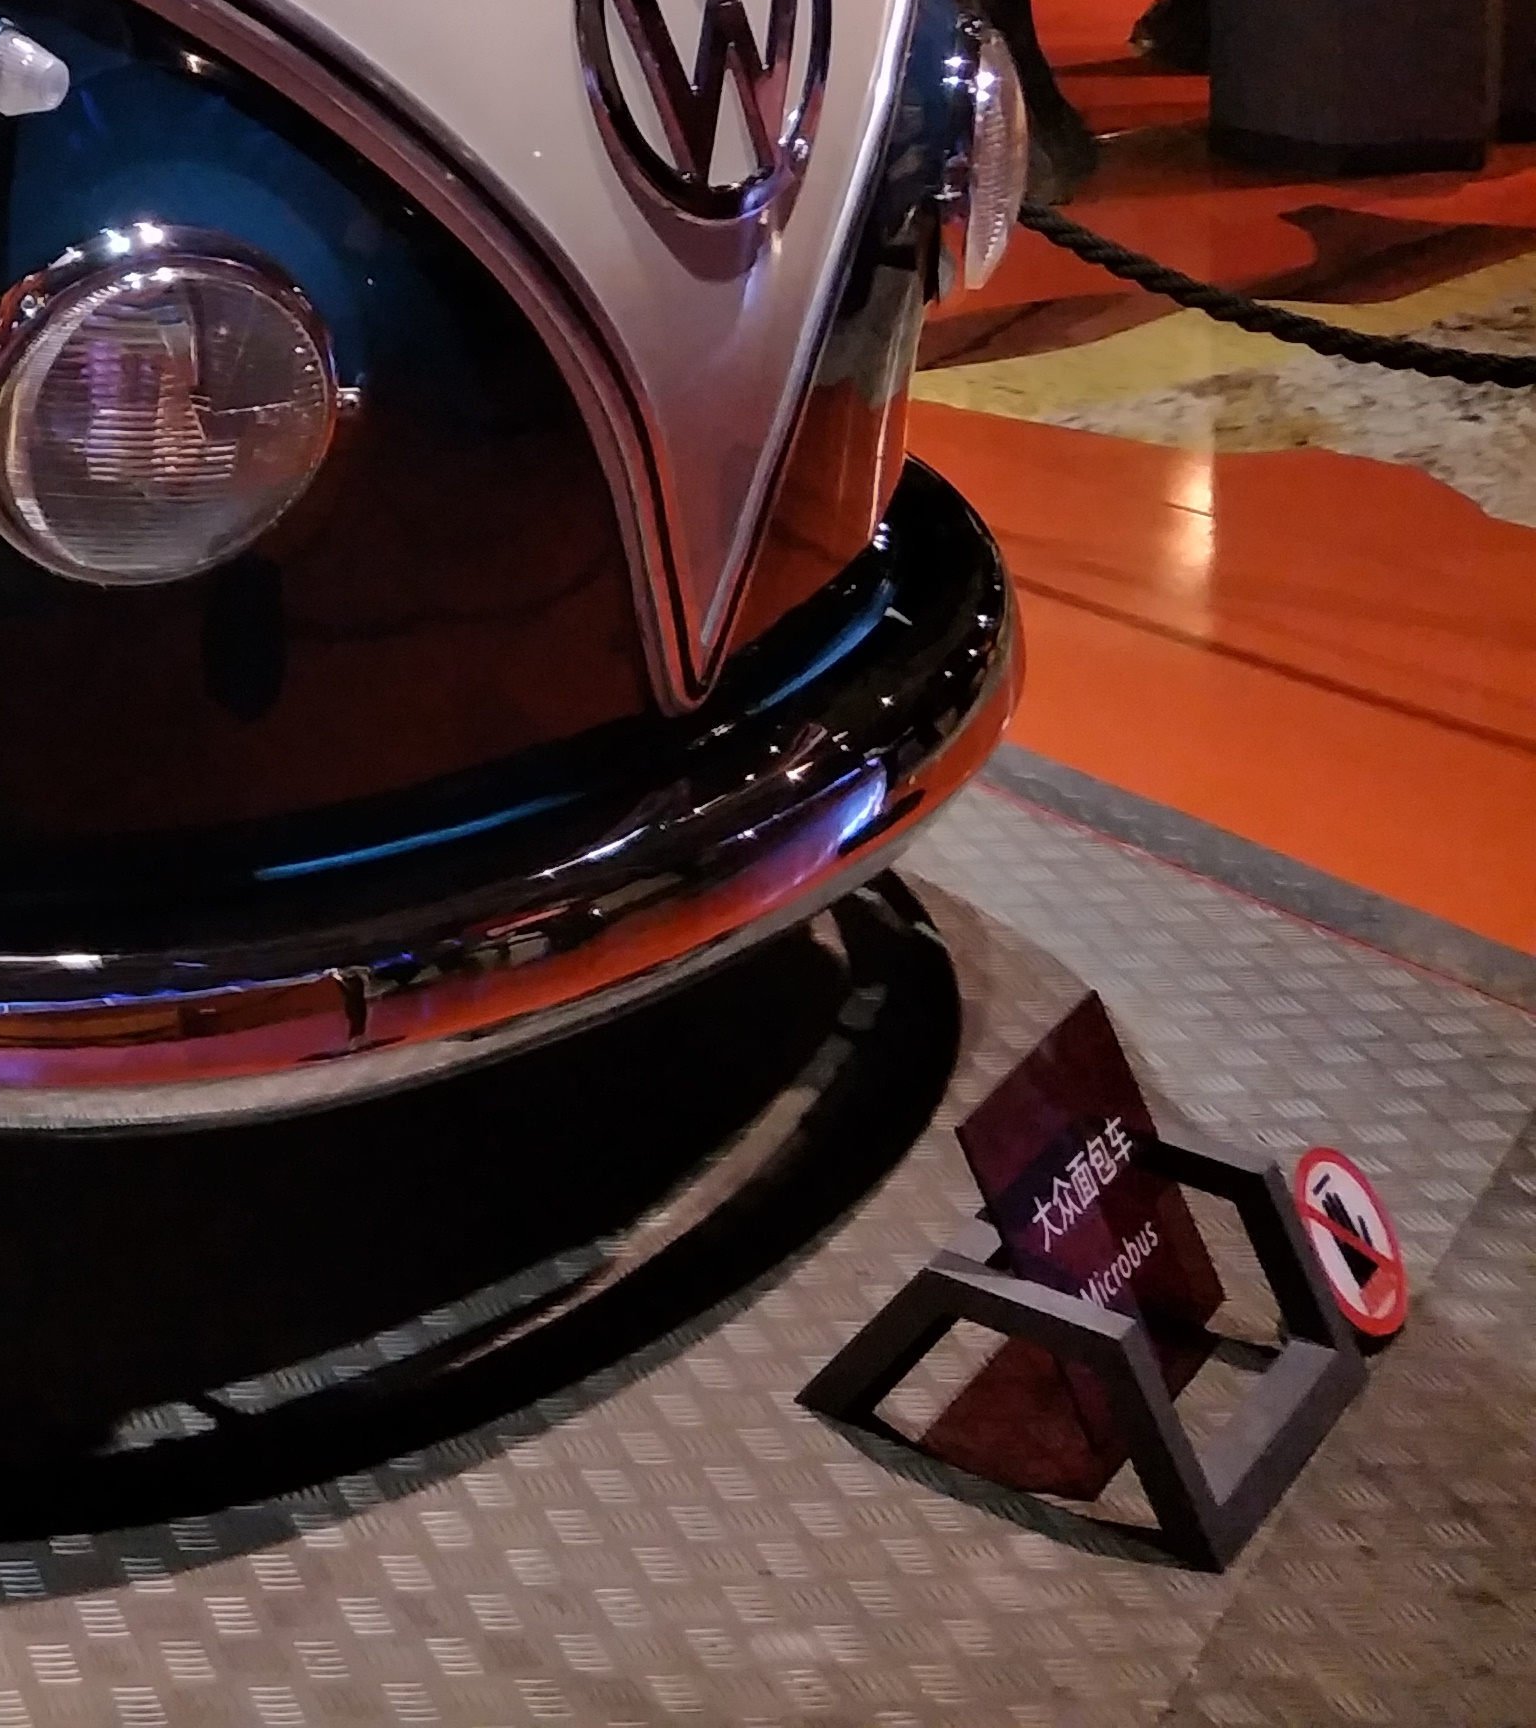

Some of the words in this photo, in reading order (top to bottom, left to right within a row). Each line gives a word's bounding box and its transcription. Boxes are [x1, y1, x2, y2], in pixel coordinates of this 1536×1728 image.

[1032, 1116, 1133, 1253] 大众面包车
